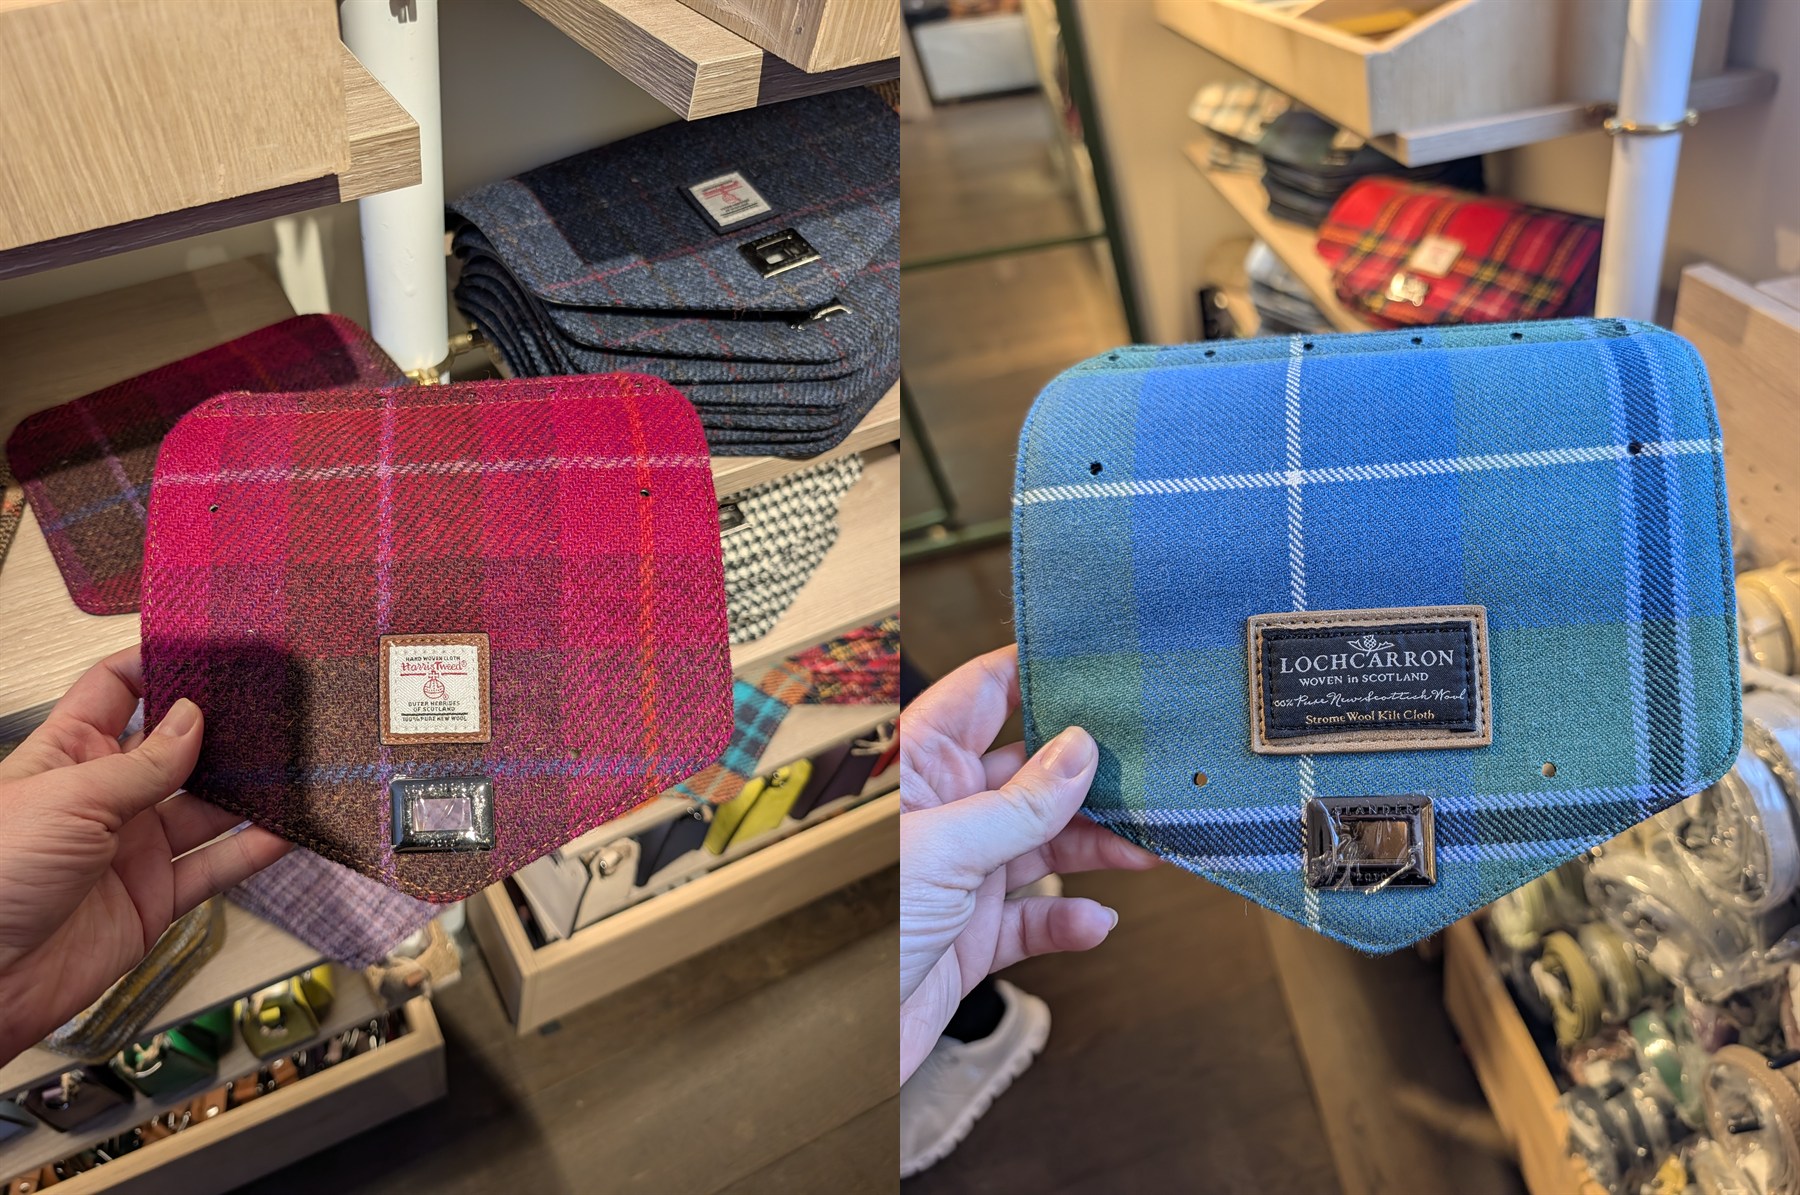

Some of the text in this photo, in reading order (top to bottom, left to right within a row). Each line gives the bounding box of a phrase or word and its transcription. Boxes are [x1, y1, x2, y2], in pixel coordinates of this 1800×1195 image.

[401, 662, 435, 671] Harris
[1280, 649, 1454, 674] LOCHCARRON
[1299, 672, 1429, 687] WOVEN in SCOTLAND
[1272, 688, 1467, 707] 00% Pure New Scottish Wool
[1305, 709, 1435, 725] Strome Wool Kilt Cloth
